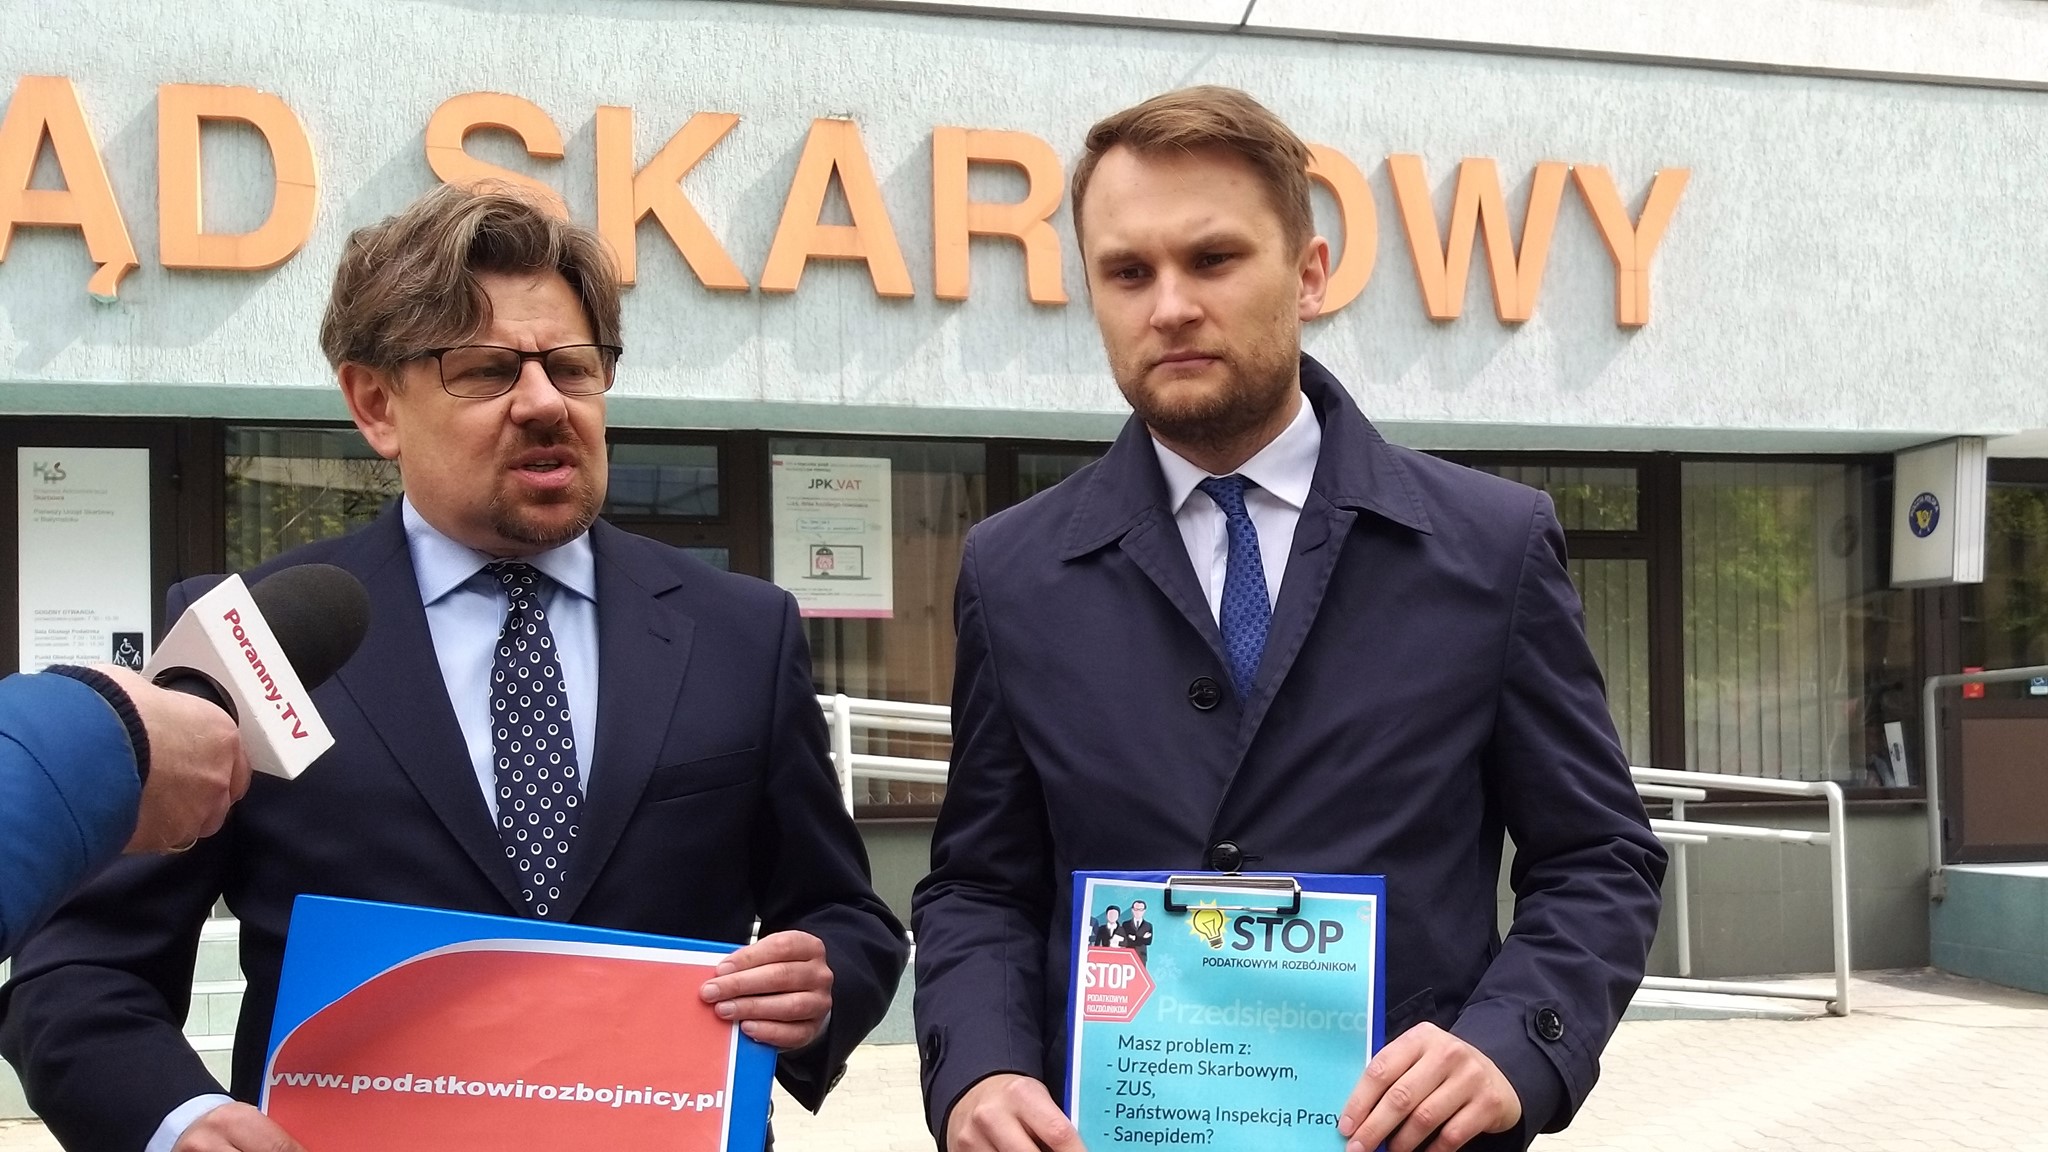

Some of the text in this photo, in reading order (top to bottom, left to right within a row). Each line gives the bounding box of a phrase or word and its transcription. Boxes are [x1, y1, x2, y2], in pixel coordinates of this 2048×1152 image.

[808, 478, 862, 491] JPK_VAT
[223, 608, 309, 739] Poranny.TV
[1231, 915, 1344, 954] STOP
[1085, 962, 1136, 989] STOP
[1202, 957, 1357, 972] PODATKOWYM ROZBÓJNIKOM
[1118, 1034, 1251, 1055] Masz problem z:
[1117, 1057, 1193, 1077] Urzędem
[1197, 1060, 1298, 1081] Skarbowym,
[1115, 1080, 1156, 1098] ZUS,
[1115, 1103, 1211, 1124] Państwową
[1216, 1106, 1292, 1127] Inspekcją
[1113, 1126, 1214, 1146] Sanepidem?
